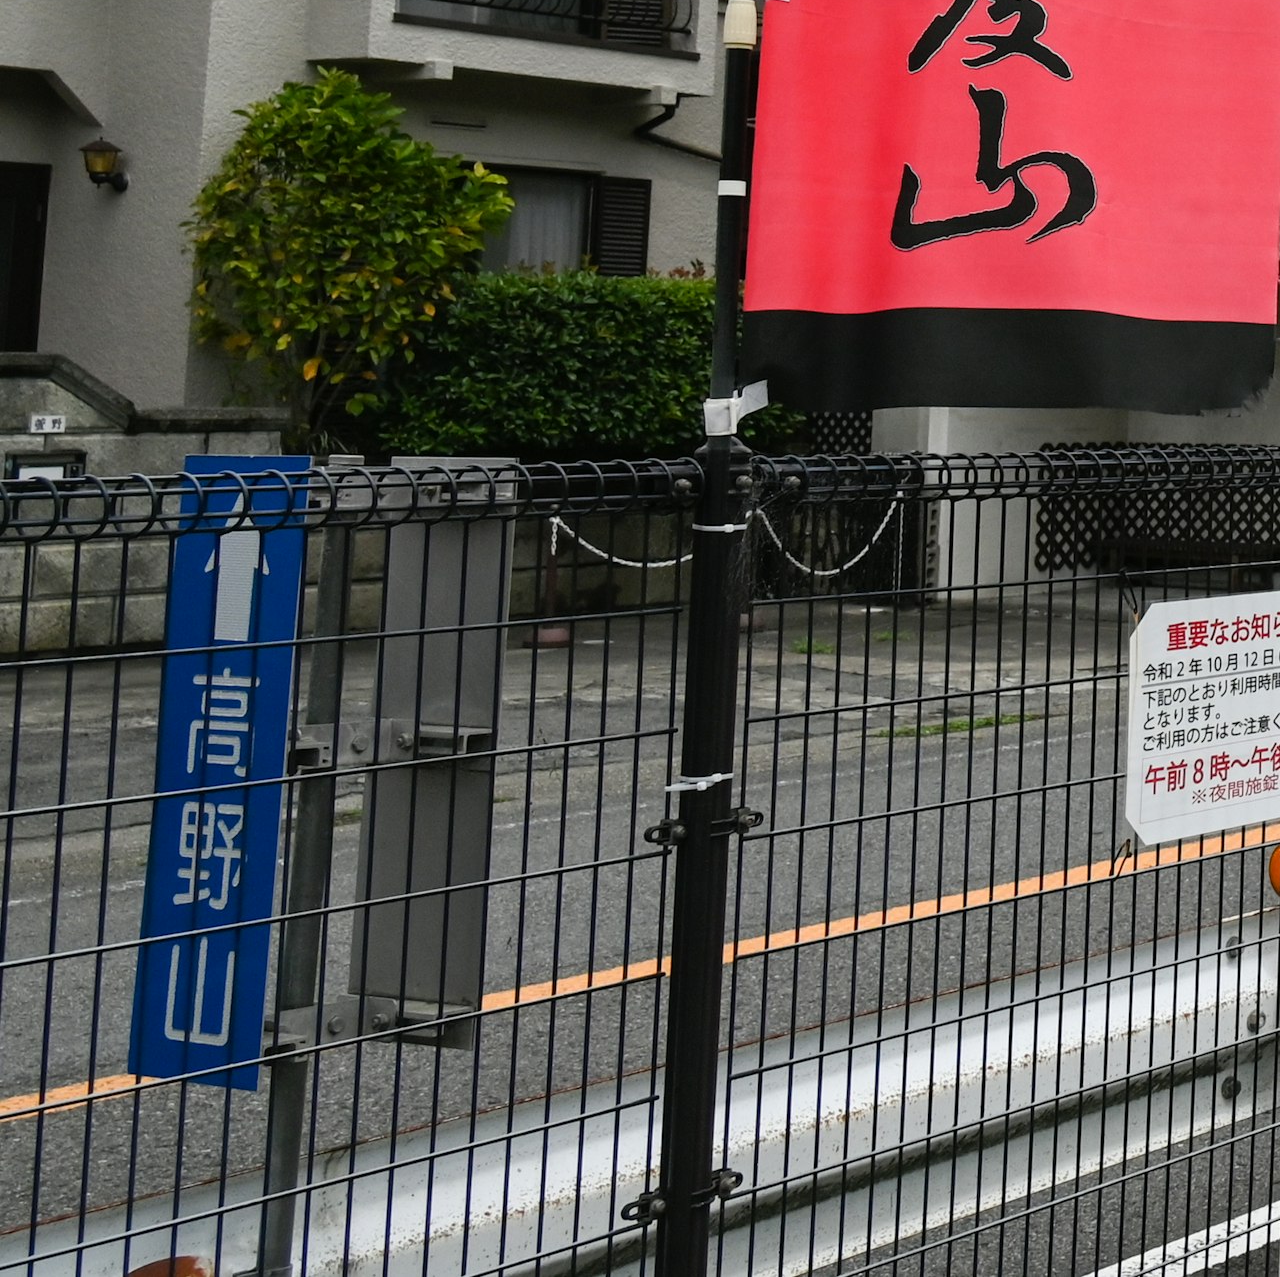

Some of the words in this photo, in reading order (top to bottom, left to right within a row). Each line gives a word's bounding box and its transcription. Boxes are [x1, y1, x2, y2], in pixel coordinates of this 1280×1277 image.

[1143, 702, 1221, 731] となります。
[164, 668, 260, 1047] 高野山
